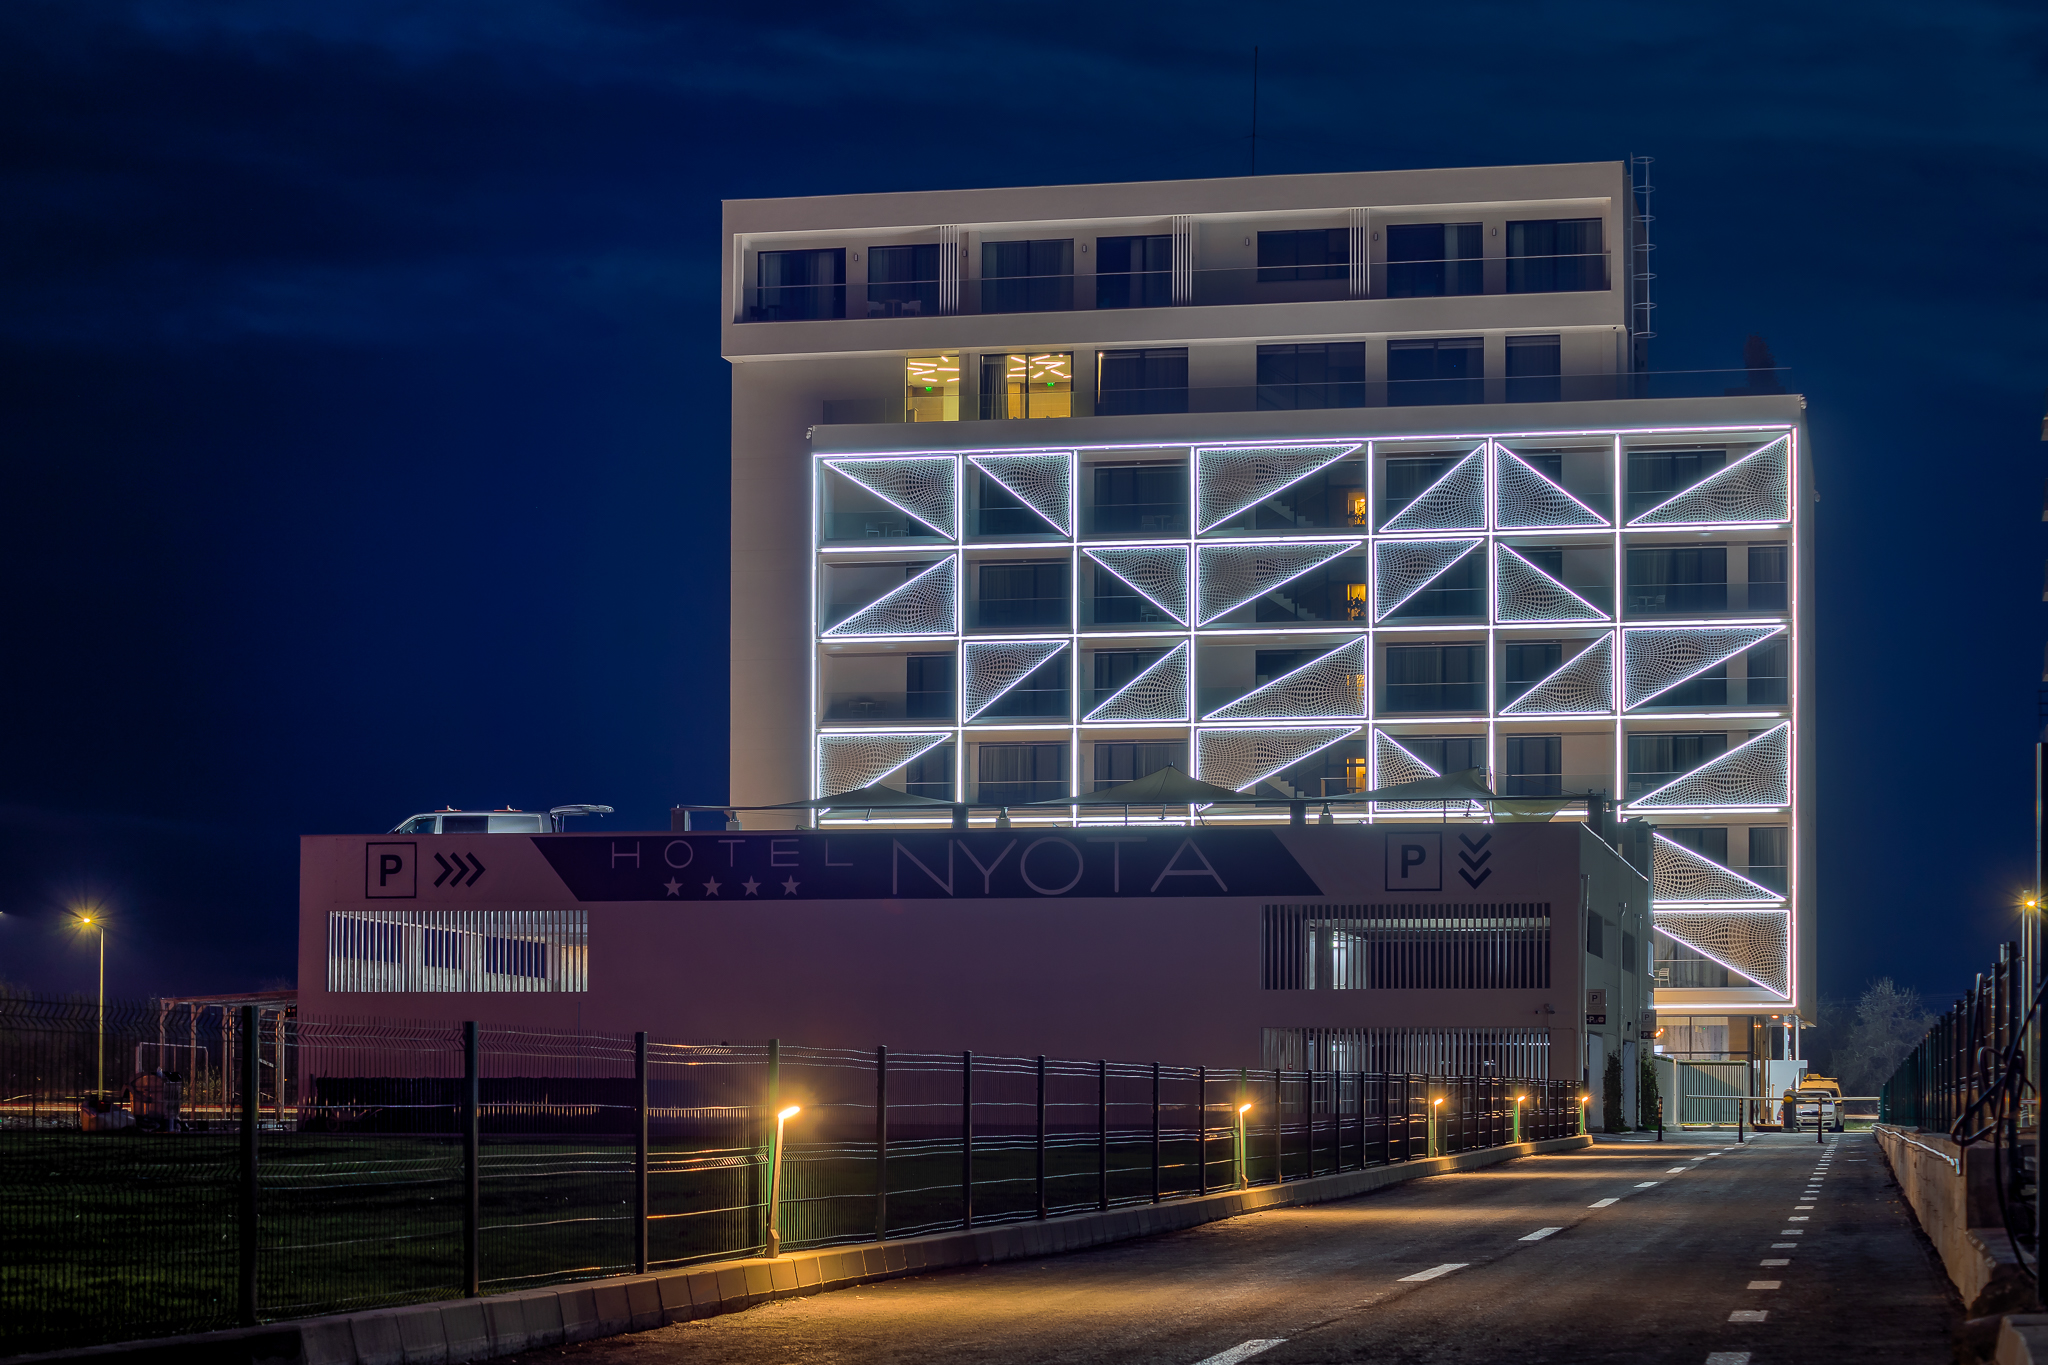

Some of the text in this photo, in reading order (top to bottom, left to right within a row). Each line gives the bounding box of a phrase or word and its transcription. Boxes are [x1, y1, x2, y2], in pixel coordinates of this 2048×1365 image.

[380, 854, 403, 887] P
[611, 836, 1229, 896] HOTEL NYOTA
[1401, 844, 1427, 878] P
